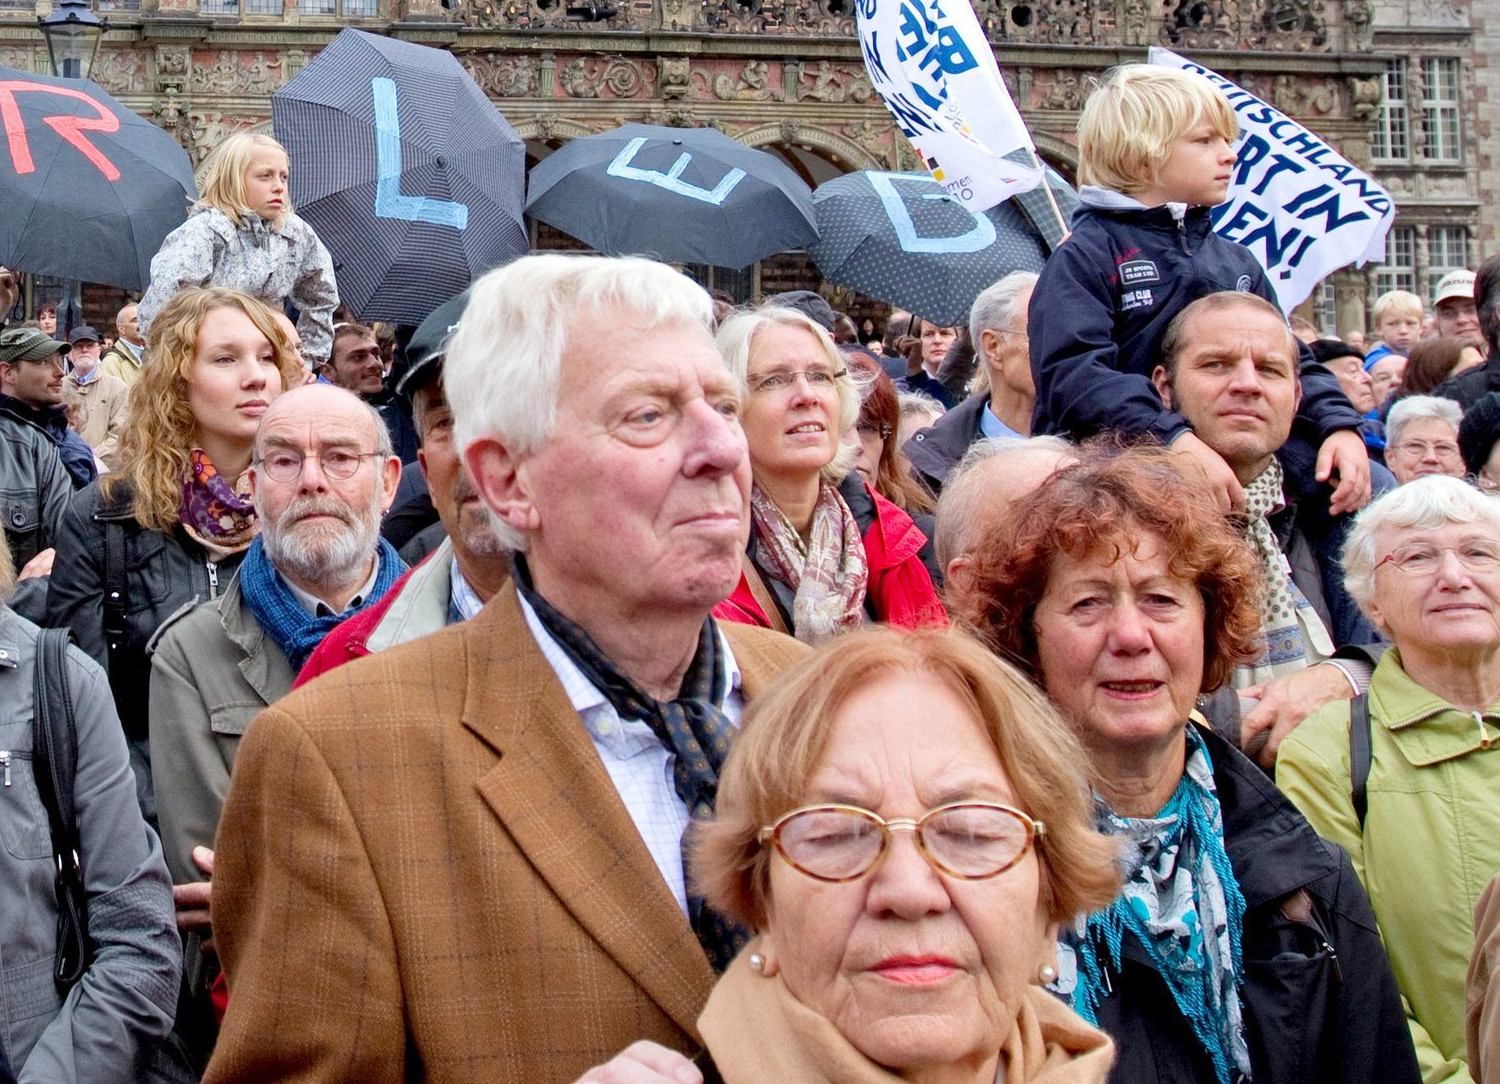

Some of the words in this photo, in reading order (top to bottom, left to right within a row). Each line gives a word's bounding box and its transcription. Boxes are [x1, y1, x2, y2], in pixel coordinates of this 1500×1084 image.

[372, 77, 468, 230] L
[607, 137, 747, 206] E
[1282, 184, 1371, 233] IN
